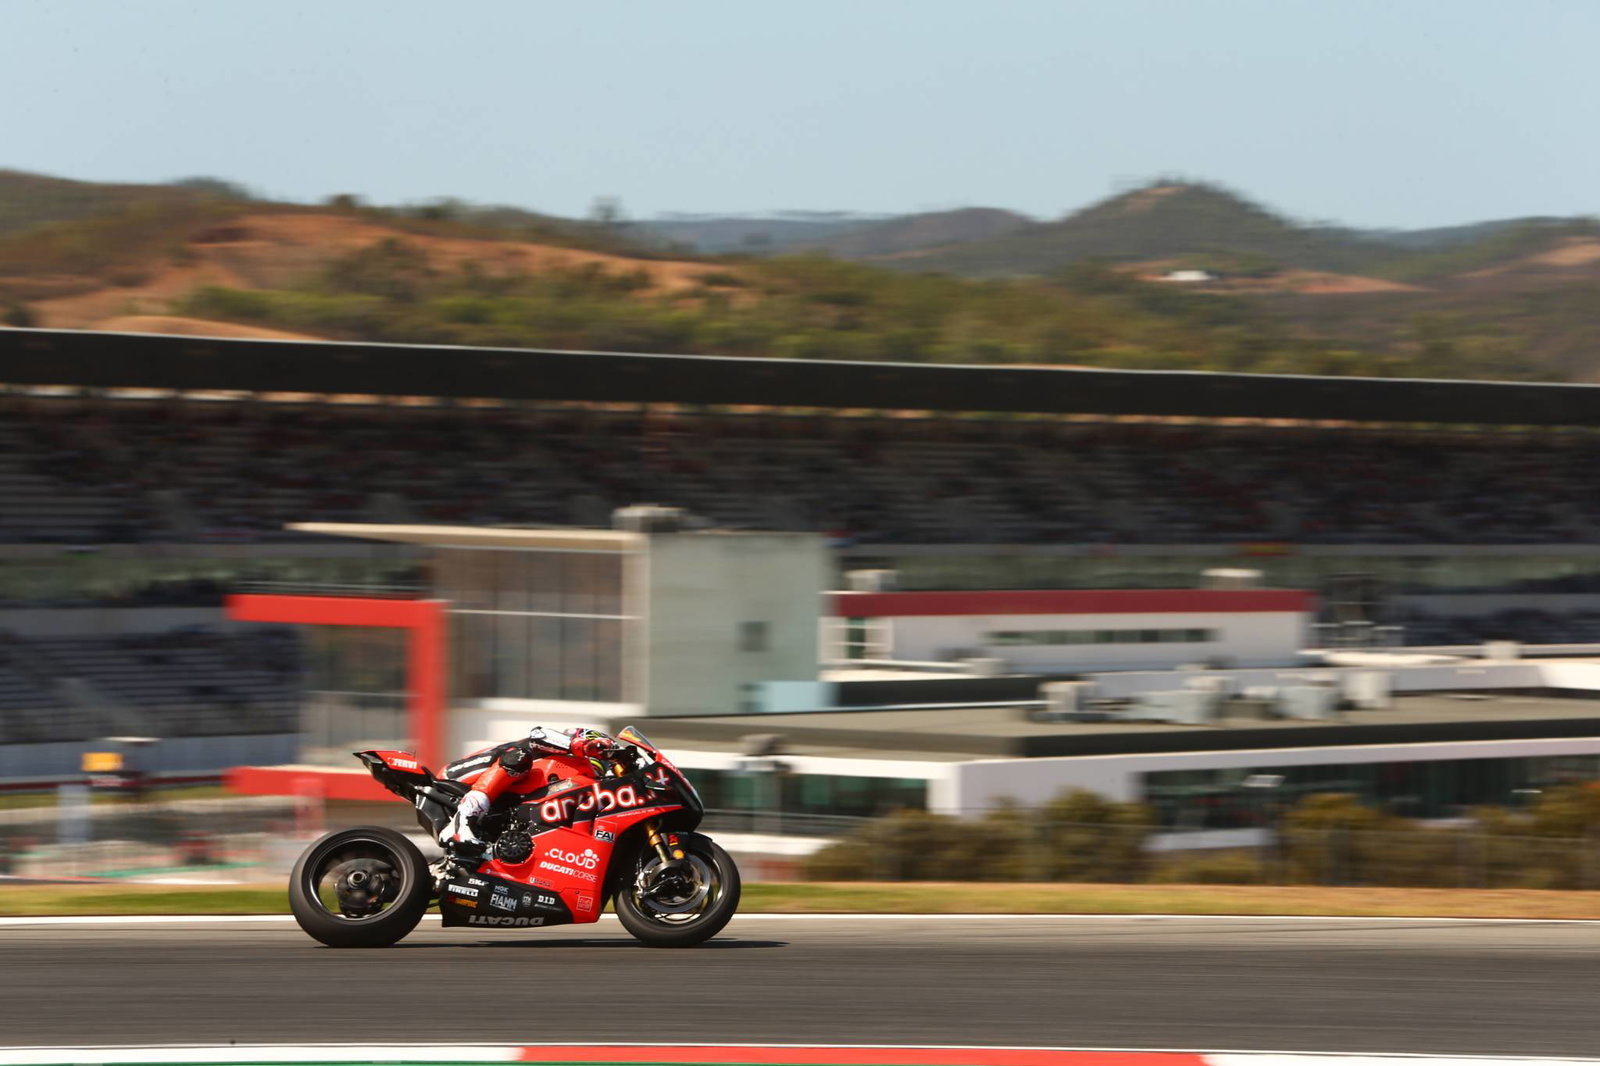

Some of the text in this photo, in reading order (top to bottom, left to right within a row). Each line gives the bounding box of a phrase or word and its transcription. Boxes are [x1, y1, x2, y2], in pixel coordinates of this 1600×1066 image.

[448, 884, 479, 897] PIRELLI
[491, 893, 517, 910] FIAMM
[468, 914, 544, 926] DUCATI
